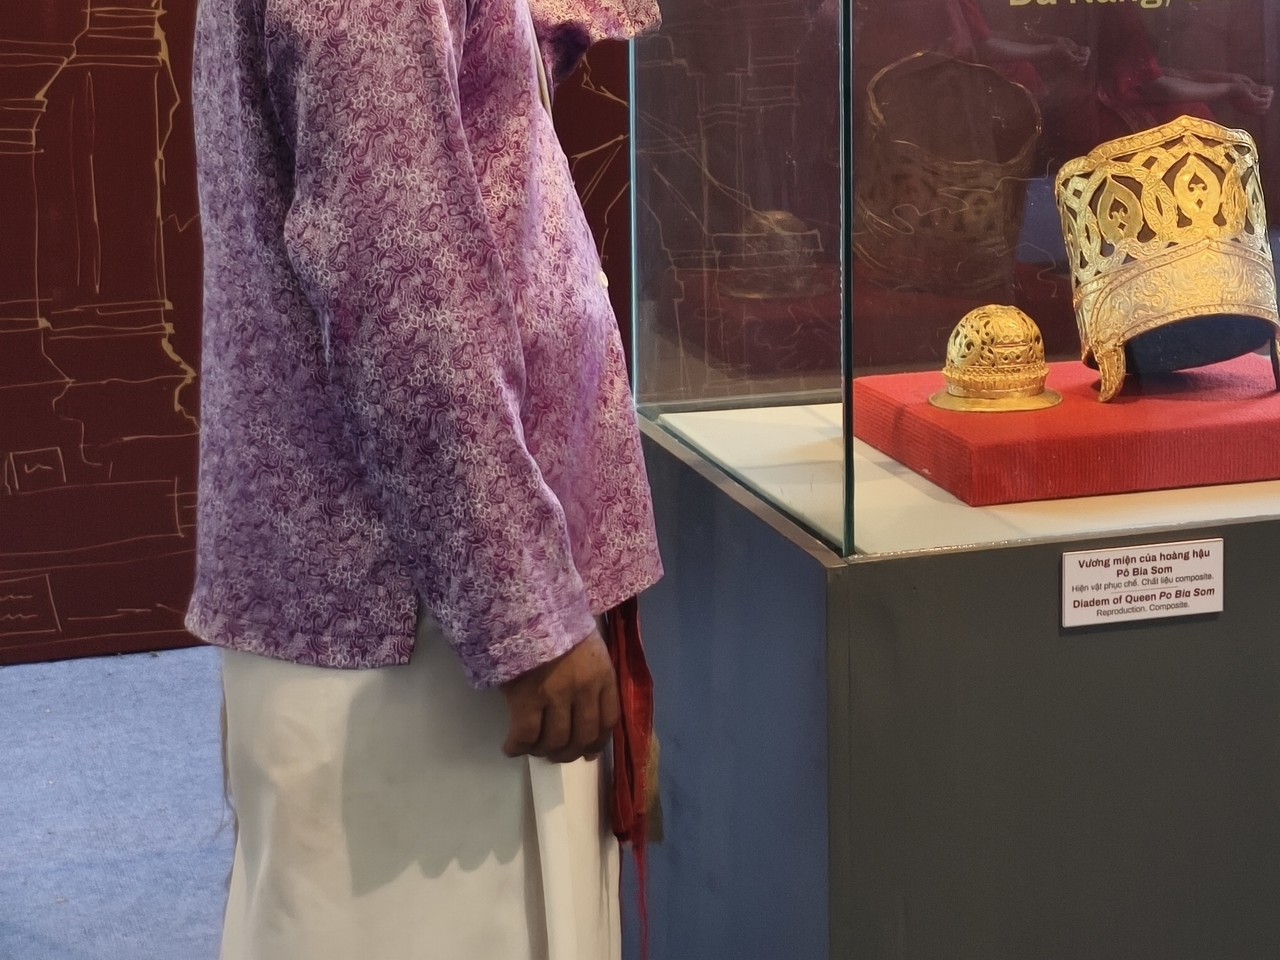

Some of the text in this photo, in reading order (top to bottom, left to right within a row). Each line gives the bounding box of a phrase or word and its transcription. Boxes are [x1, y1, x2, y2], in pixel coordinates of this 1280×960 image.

[1113, 555, 1136, 567] miện
[1140, 552, 1157, 563] của
[1160, 550, 1190, 561] hoàng
[1193, 549, 1210, 560] hậu
[1151, 565, 1173, 574] Som
[1175, 573, 1214, 583] composite.
[1073, 596, 1110, 609] Diadem
[1113, 595, 1122, 605] of
[1125, 593, 1156, 605] Queen
[1159, 591, 1172, 601] Po
[1193, 588, 1215, 597] Som
[1097, 601, 1190, 617] Reproduction. Composite.
